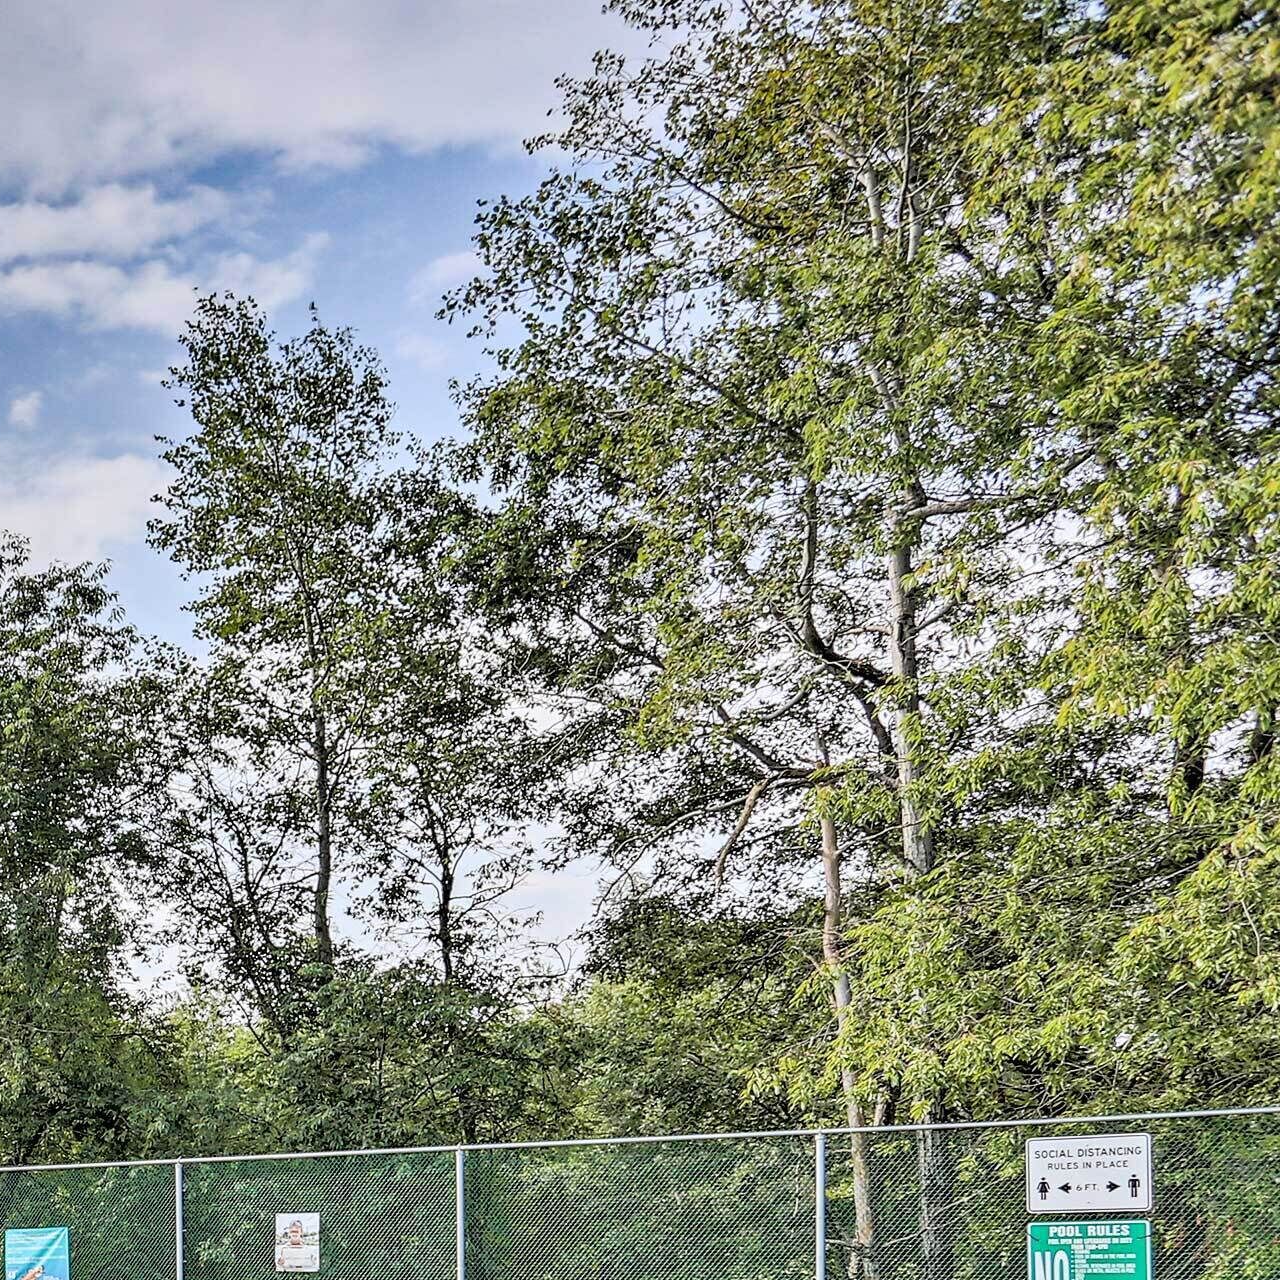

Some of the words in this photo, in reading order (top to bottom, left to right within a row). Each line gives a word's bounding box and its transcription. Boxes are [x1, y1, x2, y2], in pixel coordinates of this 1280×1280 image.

[1034, 1149, 1073, 1159] SOCIAL
[1077, 1146, 1142, 1157] DISTANCING
[1047, 1162, 1079, 1170] RULES
[1096, 1160, 1128, 1168] PLACE
[1049, 1226, 1082, 1237] POOL
[1087, 1225, 1129, 1236] RULES
